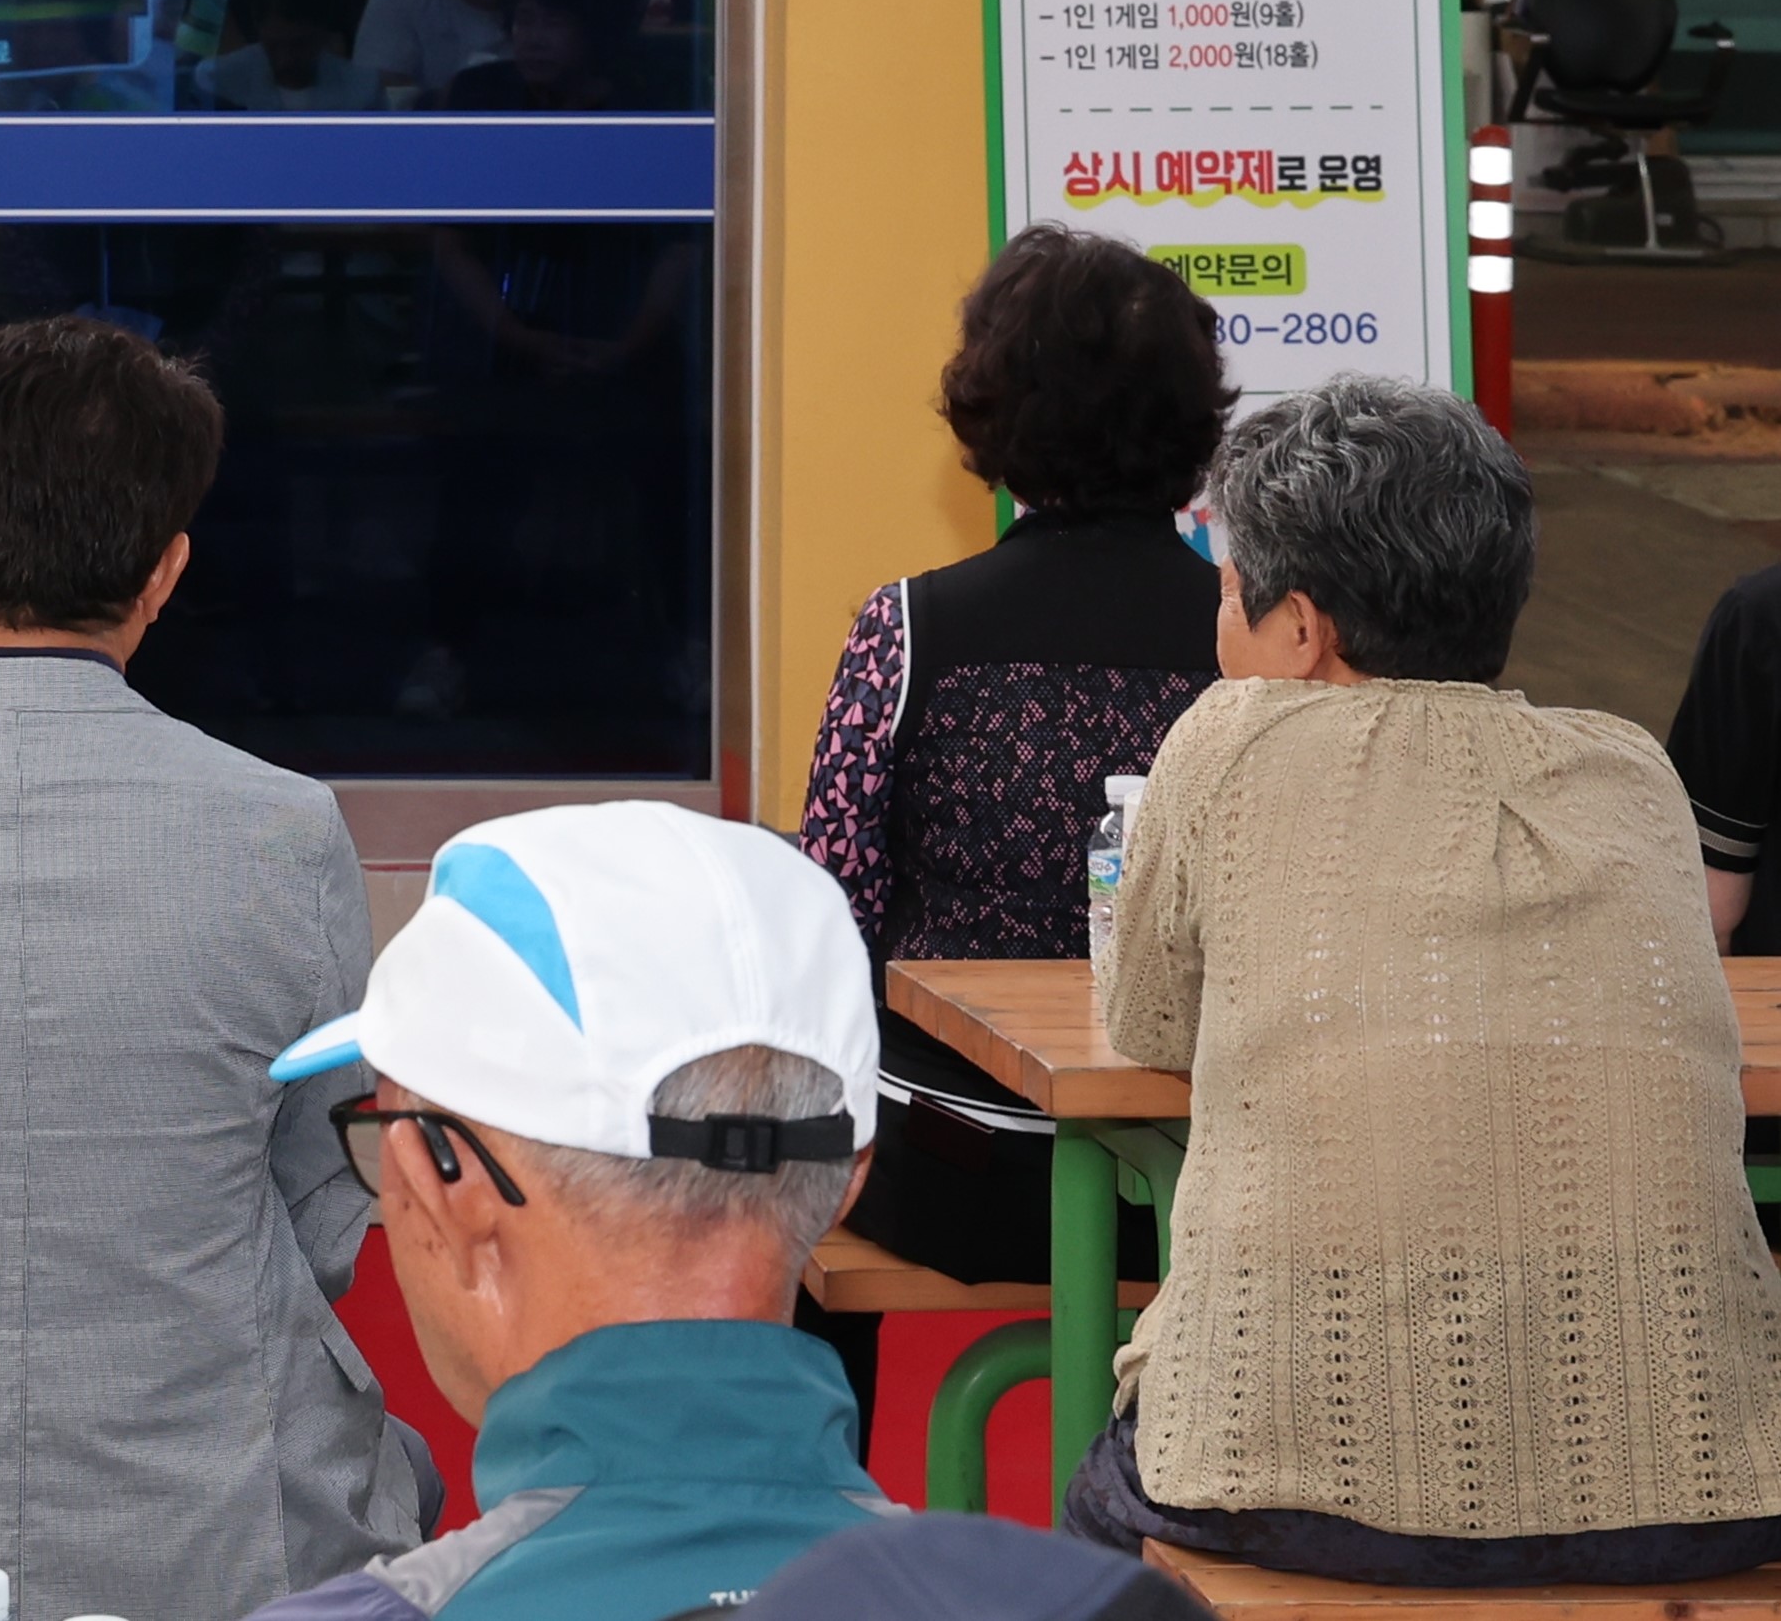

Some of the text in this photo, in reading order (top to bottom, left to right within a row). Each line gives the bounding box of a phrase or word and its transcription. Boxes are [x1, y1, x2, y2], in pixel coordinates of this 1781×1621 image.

[1063, 3, 1095, 30] 1인
[1104, 3, 1159, 29] 1게임
[1167, 0, 1305, 30] 1,000원(9홀)
[1063, 43, 1096, 71] 1인
[1105, 43, 1159, 71] 1게임
[1168, 40, 1319, 71] 2,000원(18홀)
[1063, 150, 1383, 197] 상시 예약제로 운영
